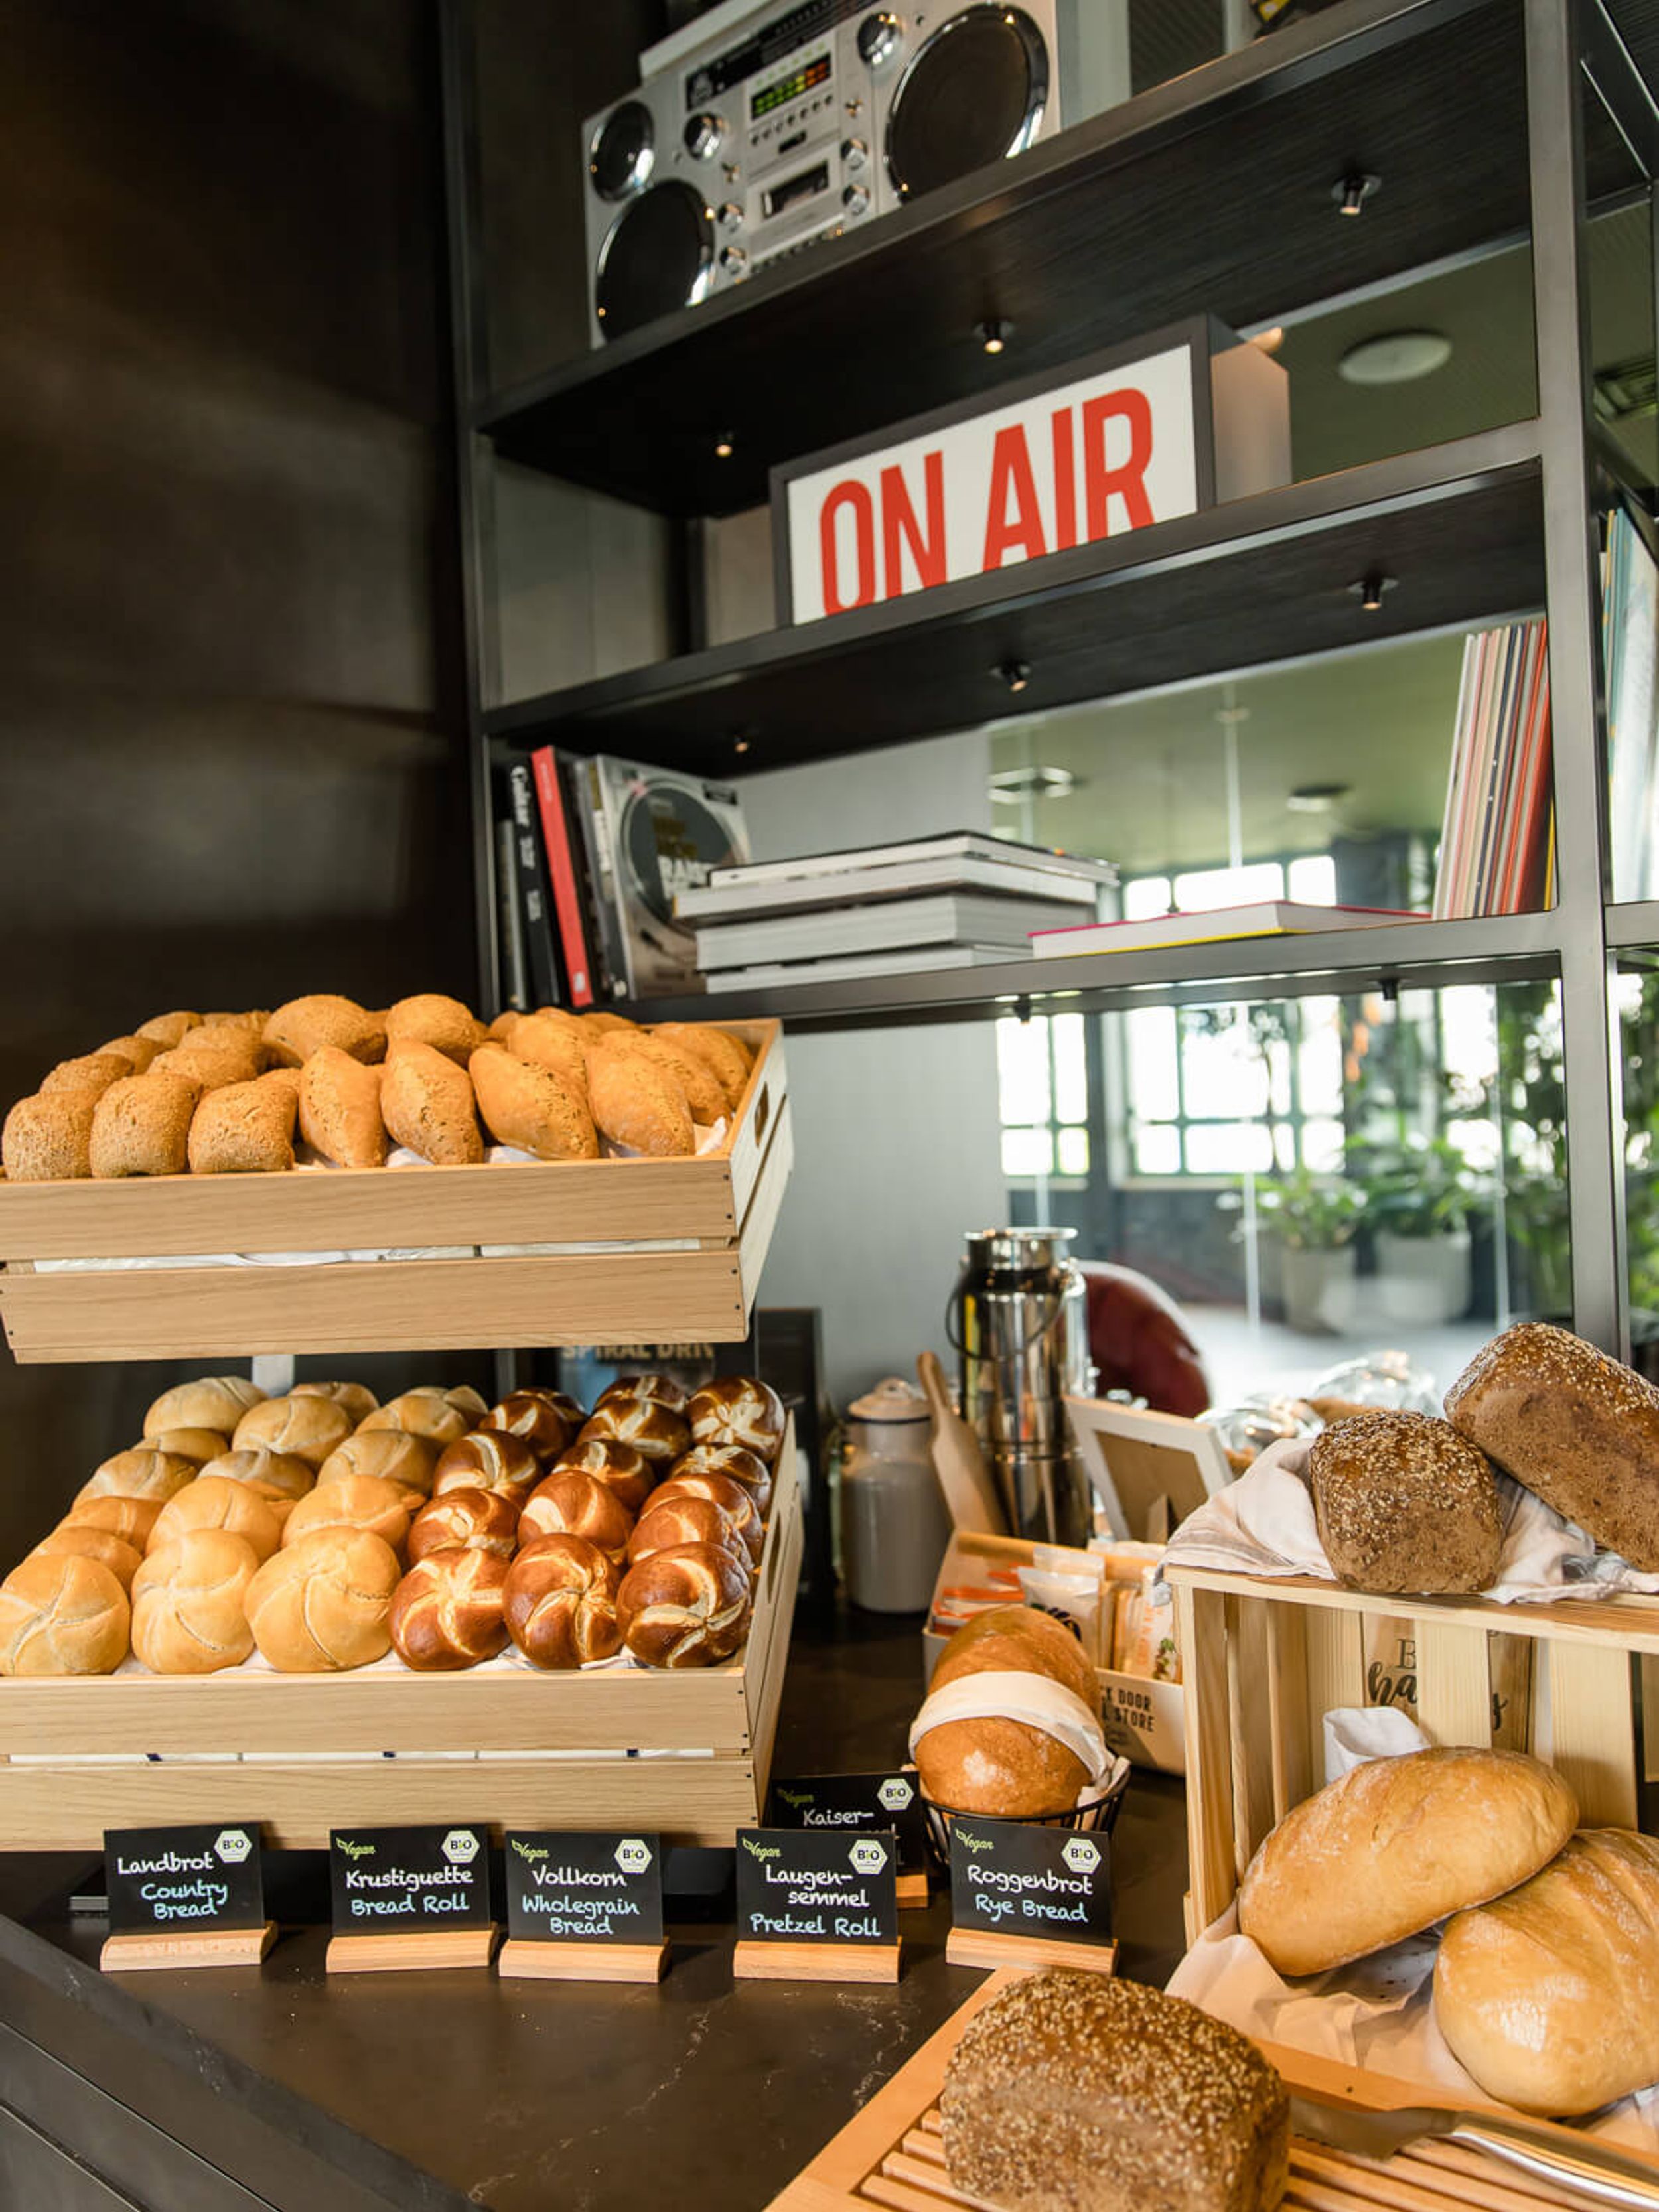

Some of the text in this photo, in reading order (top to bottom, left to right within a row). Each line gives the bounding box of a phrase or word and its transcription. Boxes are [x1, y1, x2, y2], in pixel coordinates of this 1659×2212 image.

[819, 387, 1156, 617] ON AIR
[803, 1808, 875, 1827] Kaiser-
[744, 1839, 782, 1862] Vegan
[957, 1830, 995, 1853] Vegan
[117, 1851, 214, 1874] Landbrot
[346, 1865, 474, 1892] Krustiguette
[531, 1864, 628, 1886] Vollkorn
[765, 1864, 853, 1891] Laugen-
[967, 1864, 1093, 1895] Roggenbrot
[141, 1879, 228, 1905] Country
[351, 1892, 470, 1916] Bread Roll
[787, 1888, 870, 1907] semmel
[153, 1898, 218, 1919] Bread
[522, 1894, 640, 1920] Wholegrain
[975, 1894, 1089, 1923] Rye Bread
[549, 1916, 614, 1935] Bread
[749, 1913, 882, 1937] Pretzel Roll
